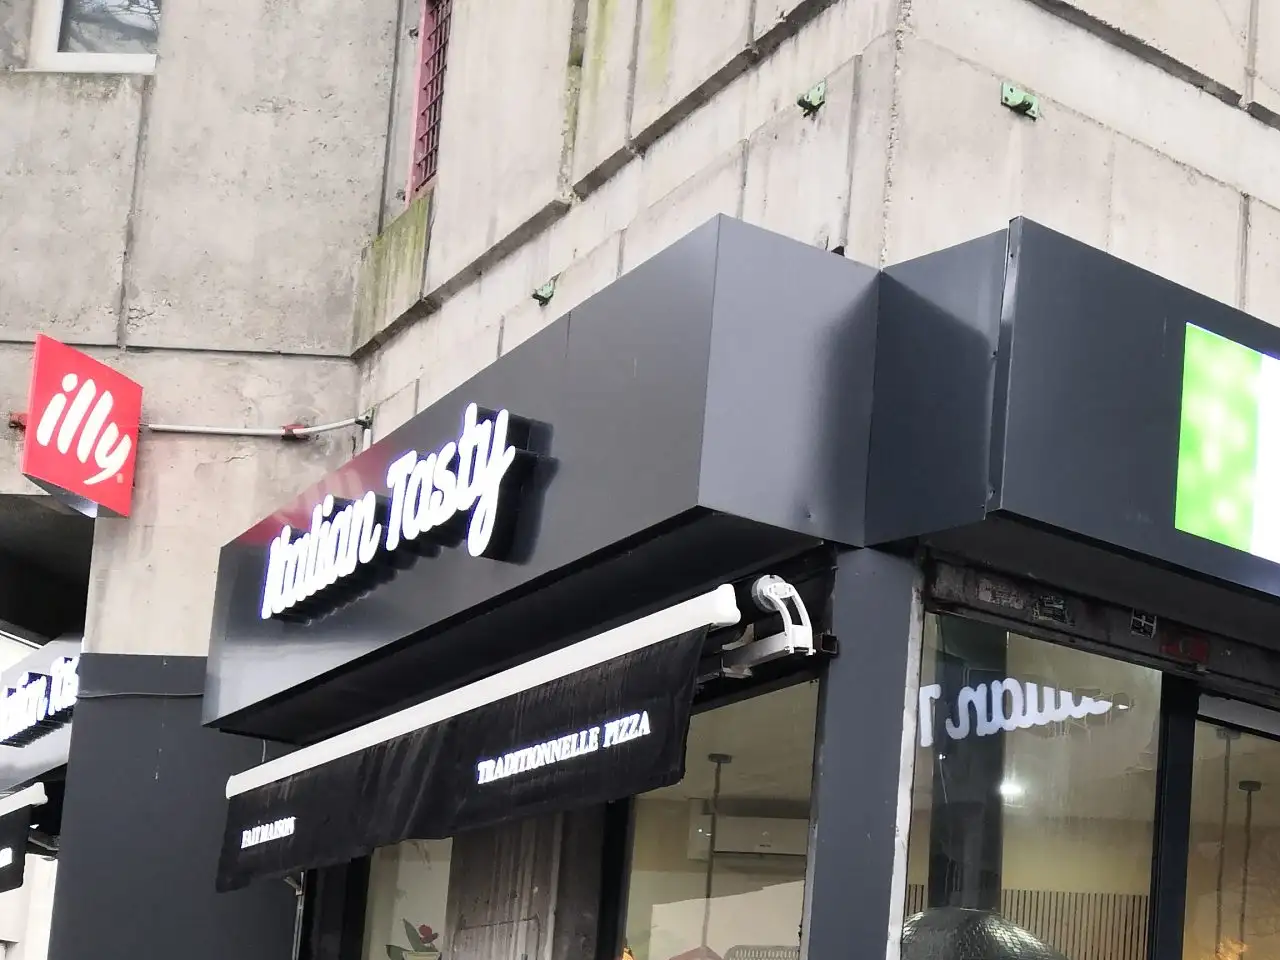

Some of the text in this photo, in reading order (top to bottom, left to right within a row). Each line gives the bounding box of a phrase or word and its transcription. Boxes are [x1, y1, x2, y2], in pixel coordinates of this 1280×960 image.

[36, 373, 132, 486] illy
[261, 402, 516, 620] Italian Tasty
[602, 710, 651, 748] PIZZA
